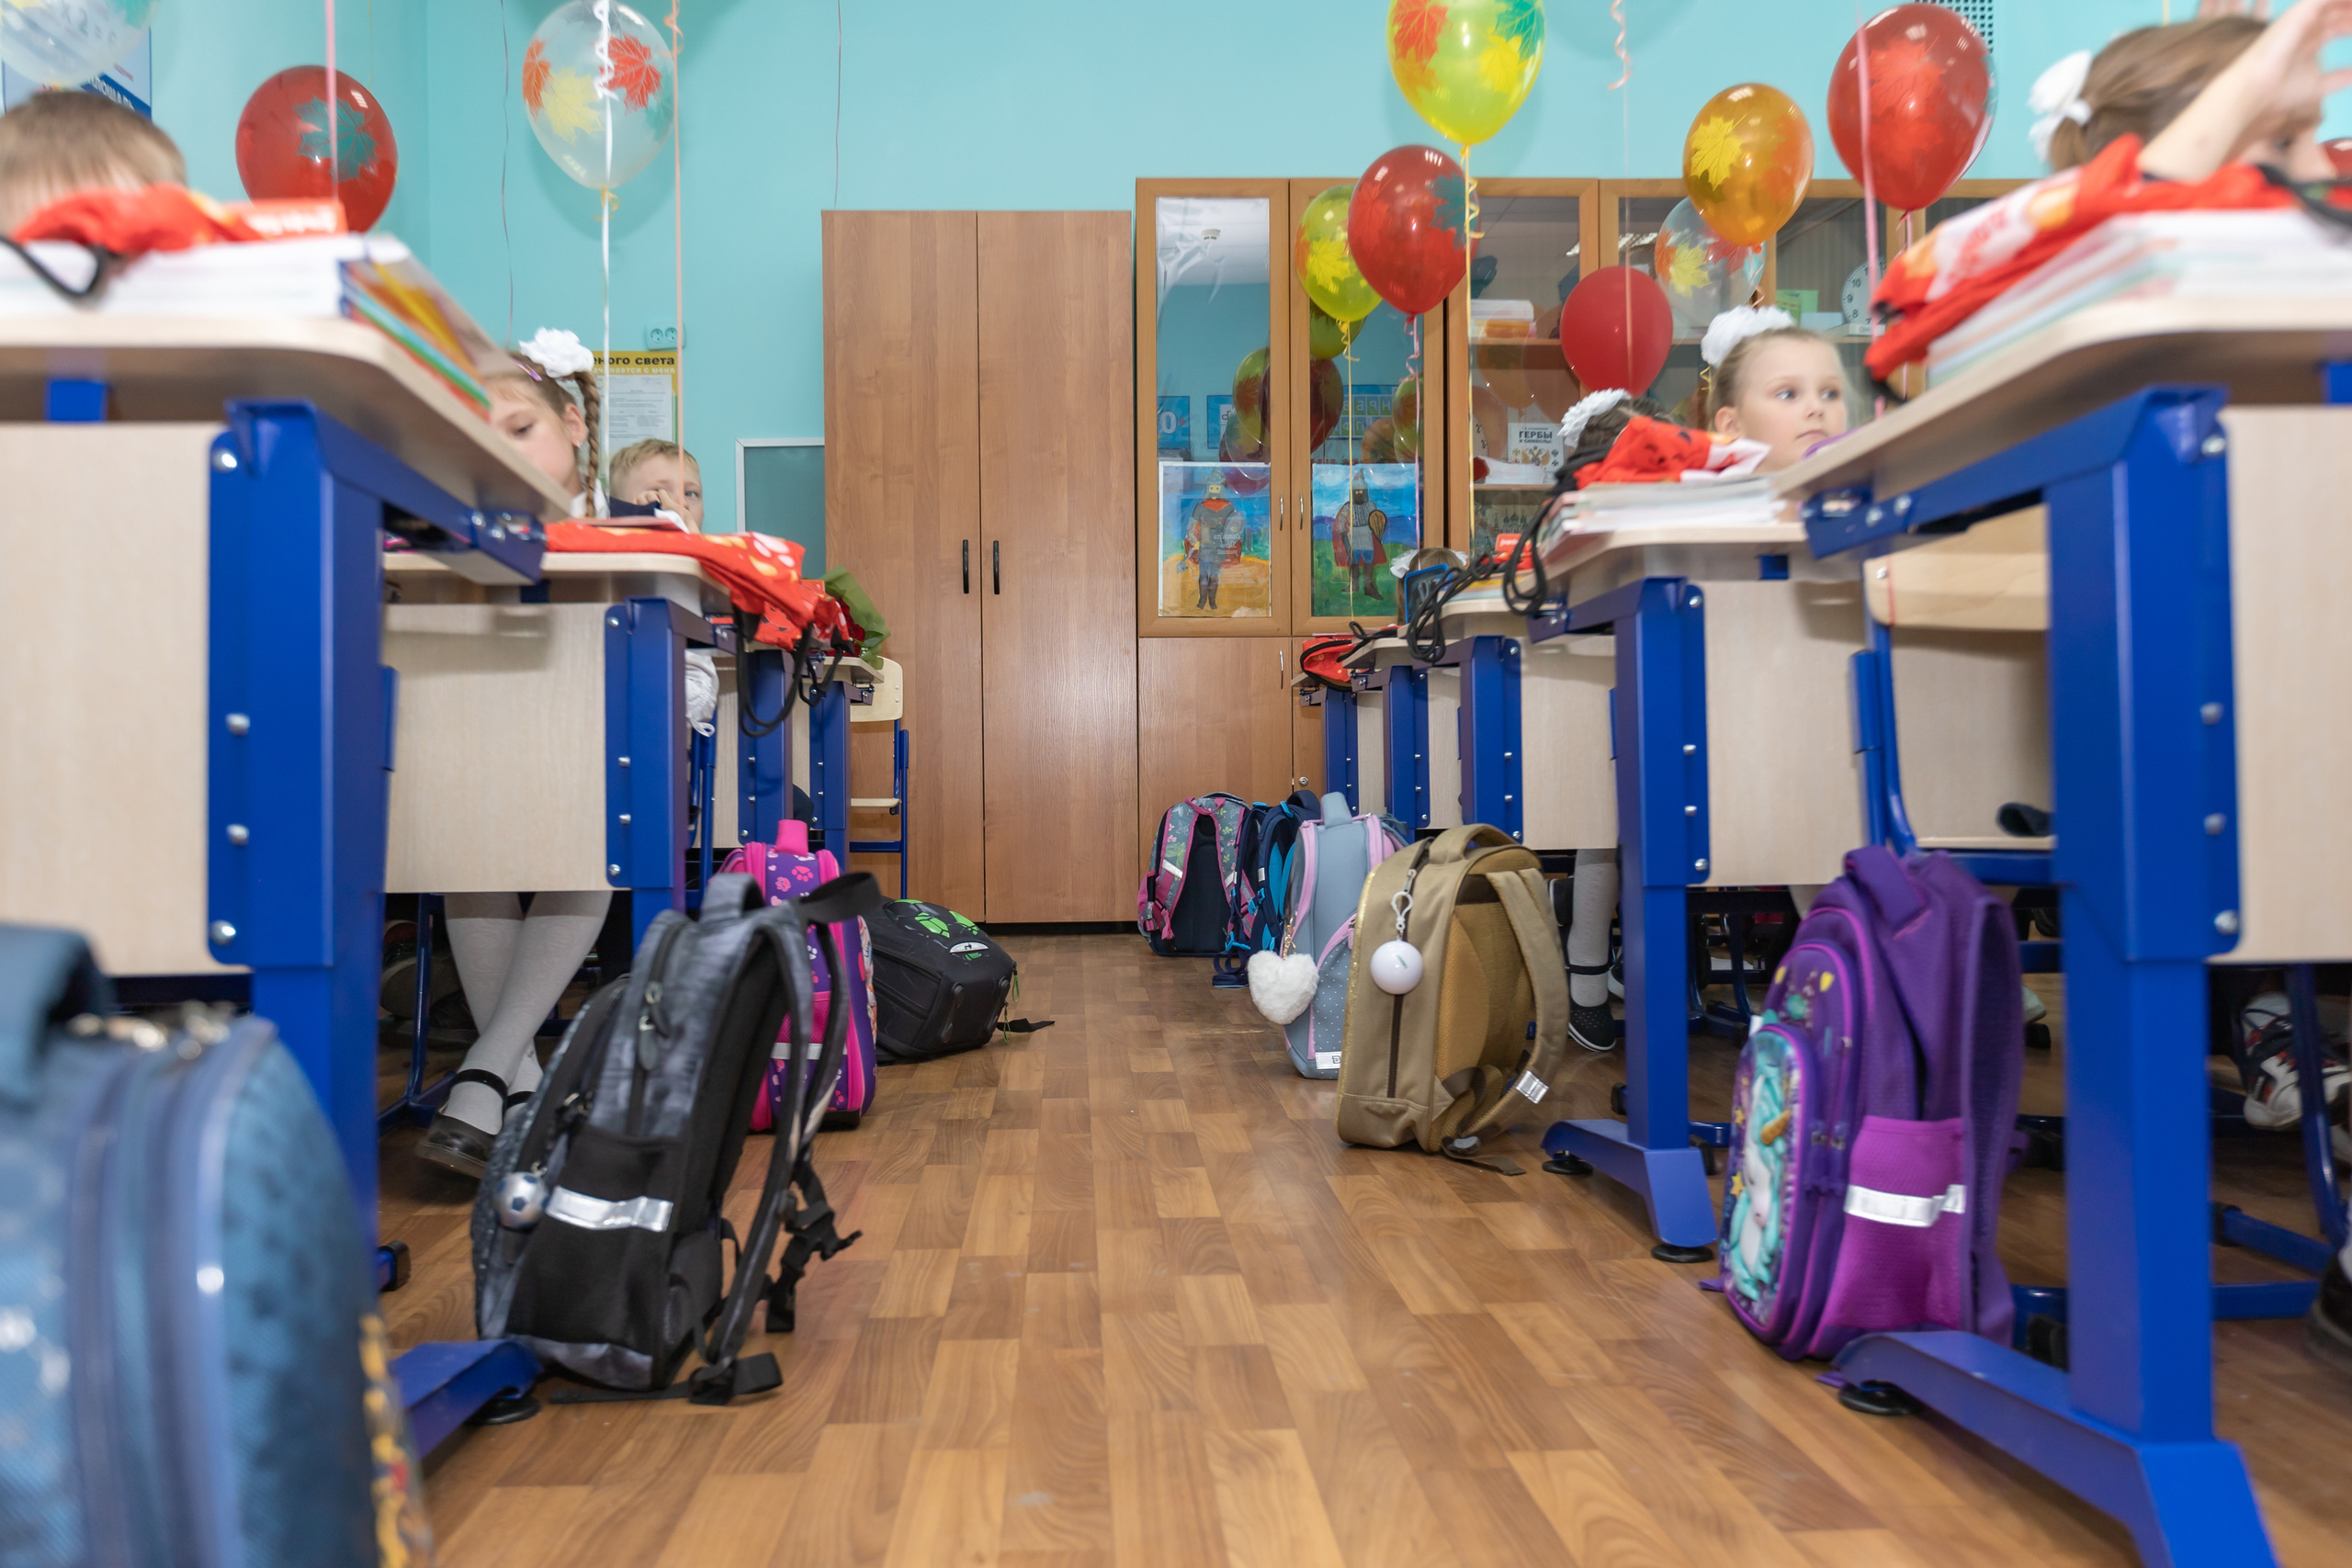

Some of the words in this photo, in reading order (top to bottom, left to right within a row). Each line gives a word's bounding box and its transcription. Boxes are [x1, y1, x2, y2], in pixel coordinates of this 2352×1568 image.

[1852, 278, 1861, 288] 10
[635, 357, 675, 366] света
[1519, 431, 1553, 439] ГЕРБЫ
